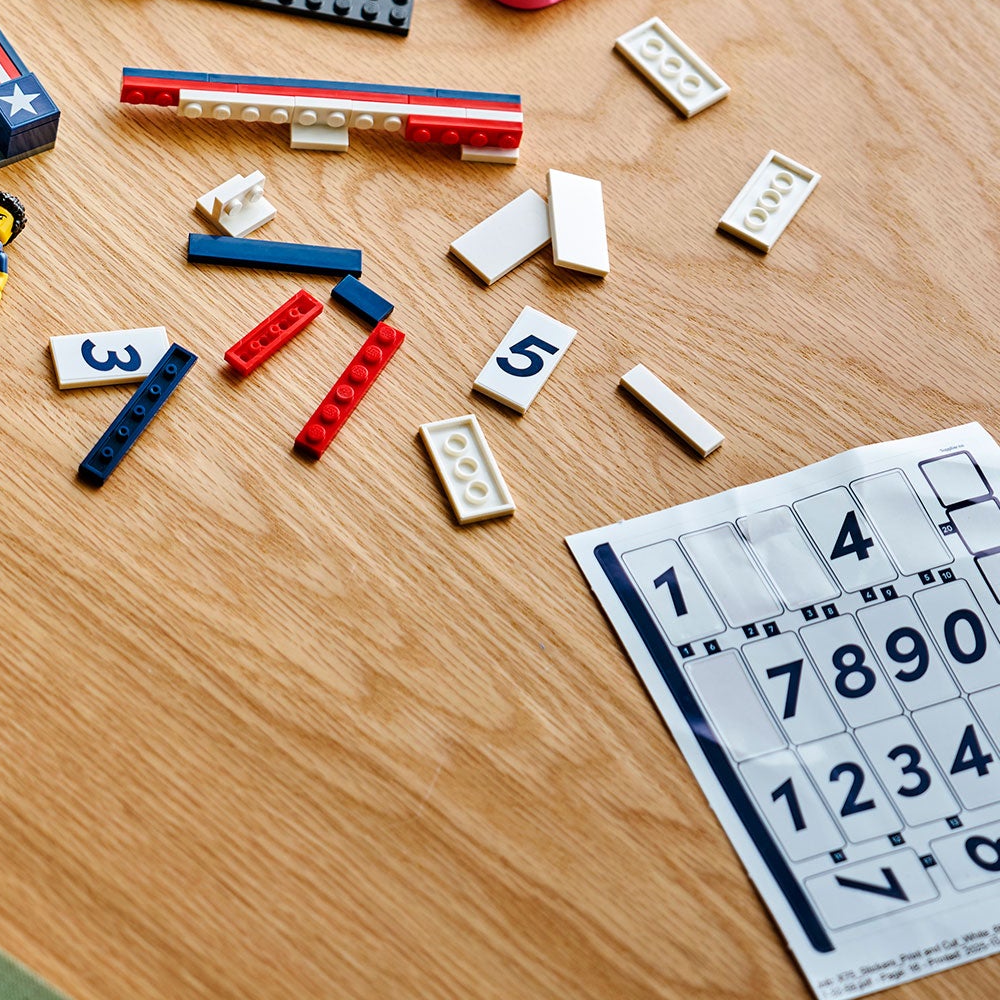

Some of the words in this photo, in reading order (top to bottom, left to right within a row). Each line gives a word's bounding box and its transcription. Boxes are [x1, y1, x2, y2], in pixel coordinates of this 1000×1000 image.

[81, 339, 142, 372] 3
[496, 334, 560, 377] 5
[830, 510, 875, 560] 4
[941, 524, 953, 534] 20
[653, 566, 689, 617] 1
[942, 571, 953, 580] 10
[766, 658, 804, 720] 7
[831, 643, 877, 699] 8
[885, 626, 930, 683] 9
[943, 608, 988, 665] 0
[771, 777, 807, 831] 1
[829, 761, 876, 817] 2
[887, 744, 932, 798] 3
[950, 724, 994, 777] 4
[834, 867, 910, 902] 7
